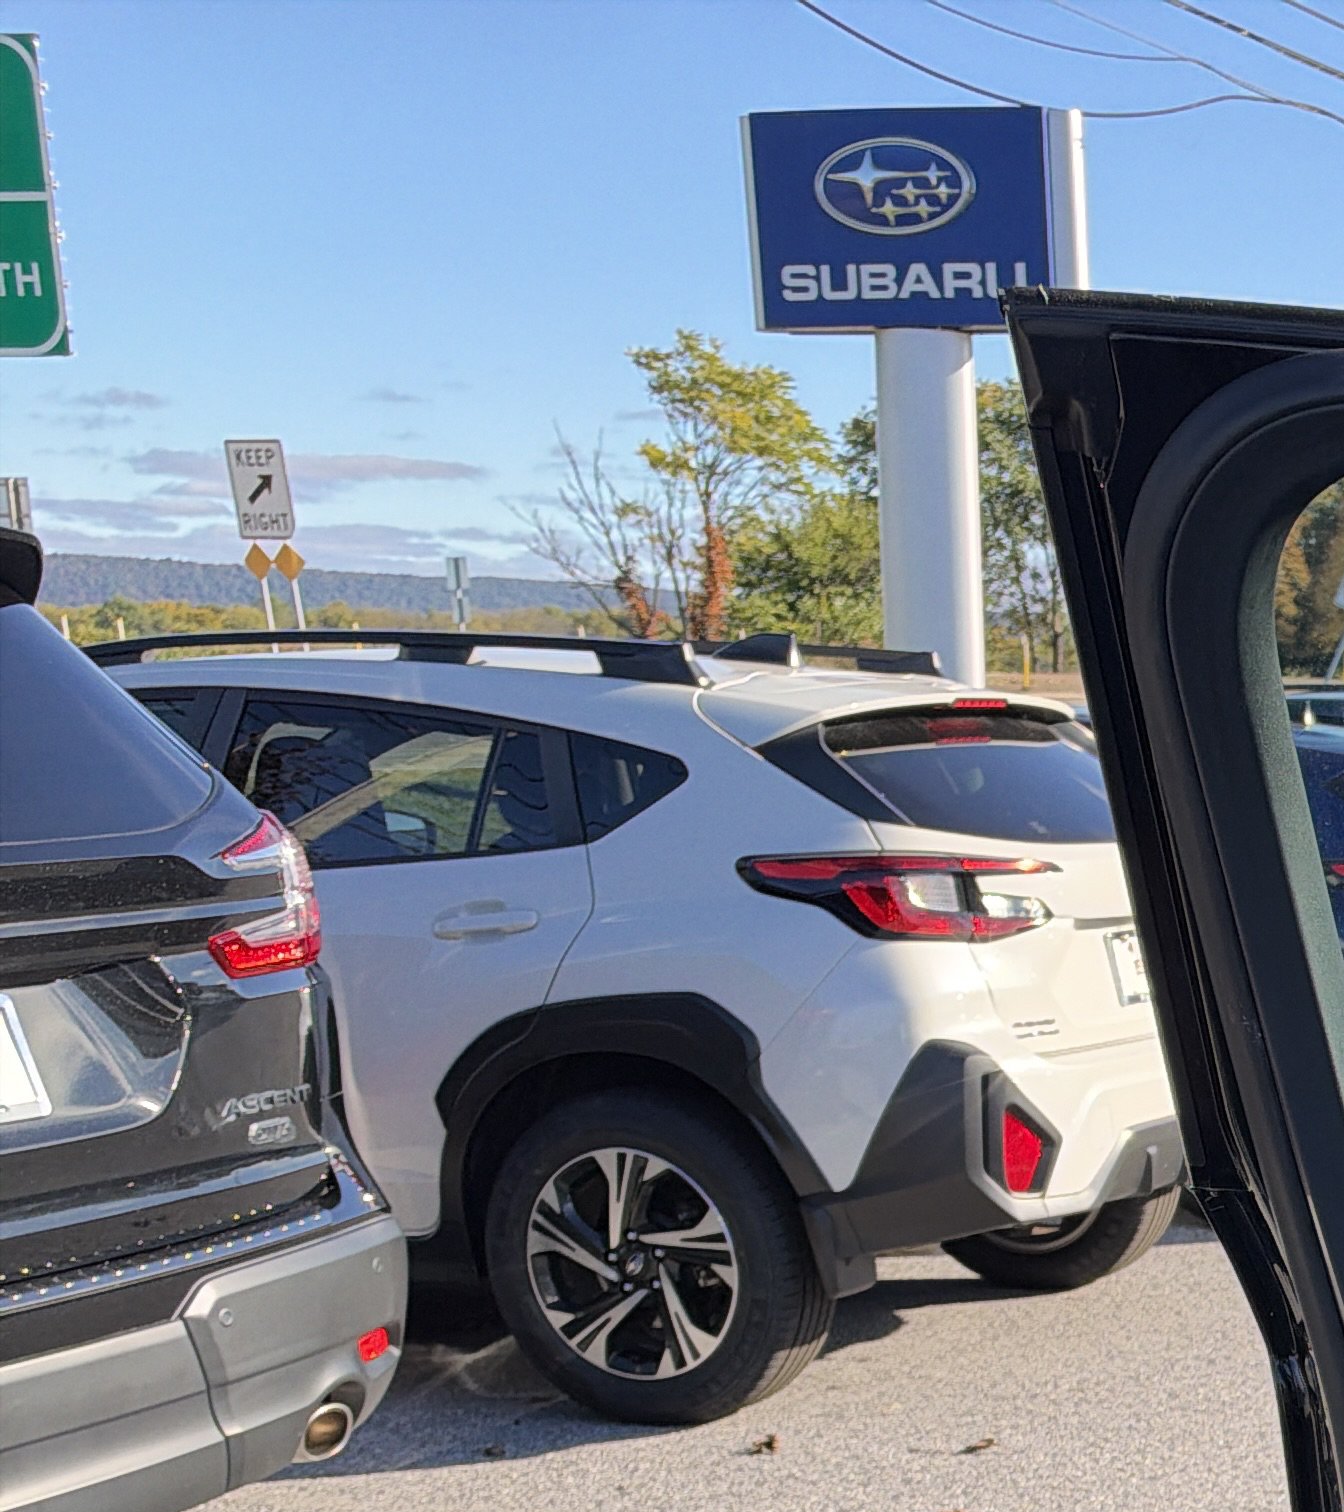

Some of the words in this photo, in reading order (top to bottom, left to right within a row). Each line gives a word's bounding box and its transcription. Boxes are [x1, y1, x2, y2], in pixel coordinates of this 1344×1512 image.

[781, 262, 1028, 301] SUBARU
[234, 448, 275, 468] KEEP
[241, 512, 289, 531] RIGHT
[220, 1083, 311, 1122] ASCENT
